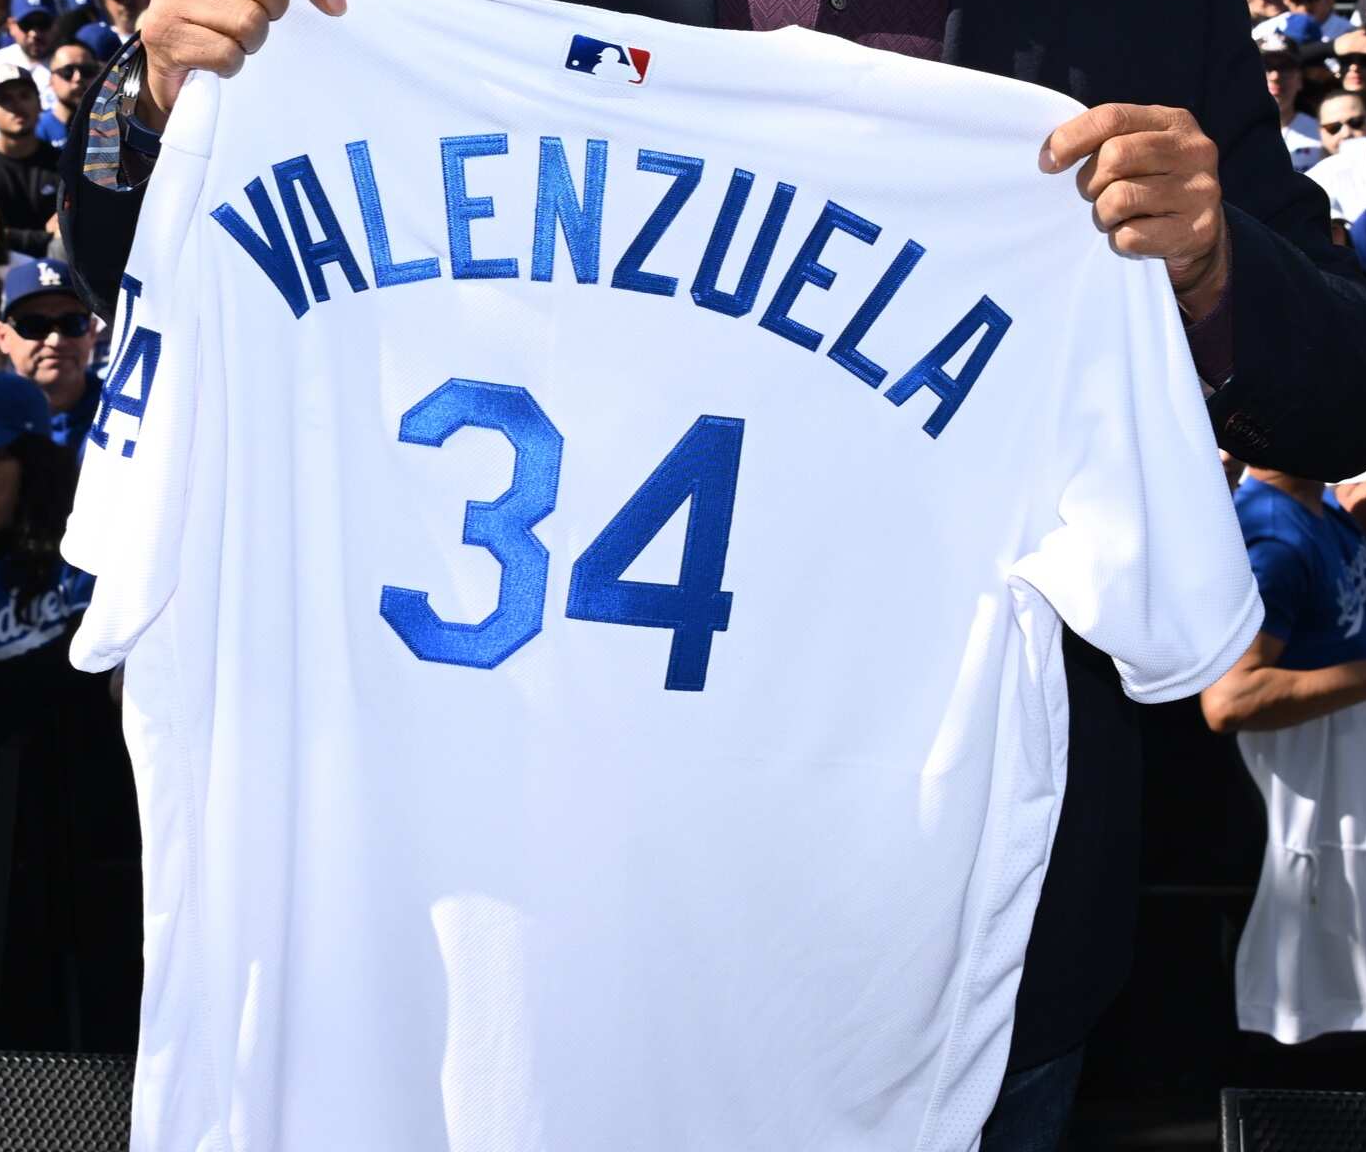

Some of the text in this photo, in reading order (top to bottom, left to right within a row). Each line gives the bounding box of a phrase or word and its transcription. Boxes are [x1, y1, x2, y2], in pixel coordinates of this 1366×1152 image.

[37, 261, 61, 287] LA
[210, 133, 1013, 439] VALENZUELA
[379, 377, 746, 691] 34
